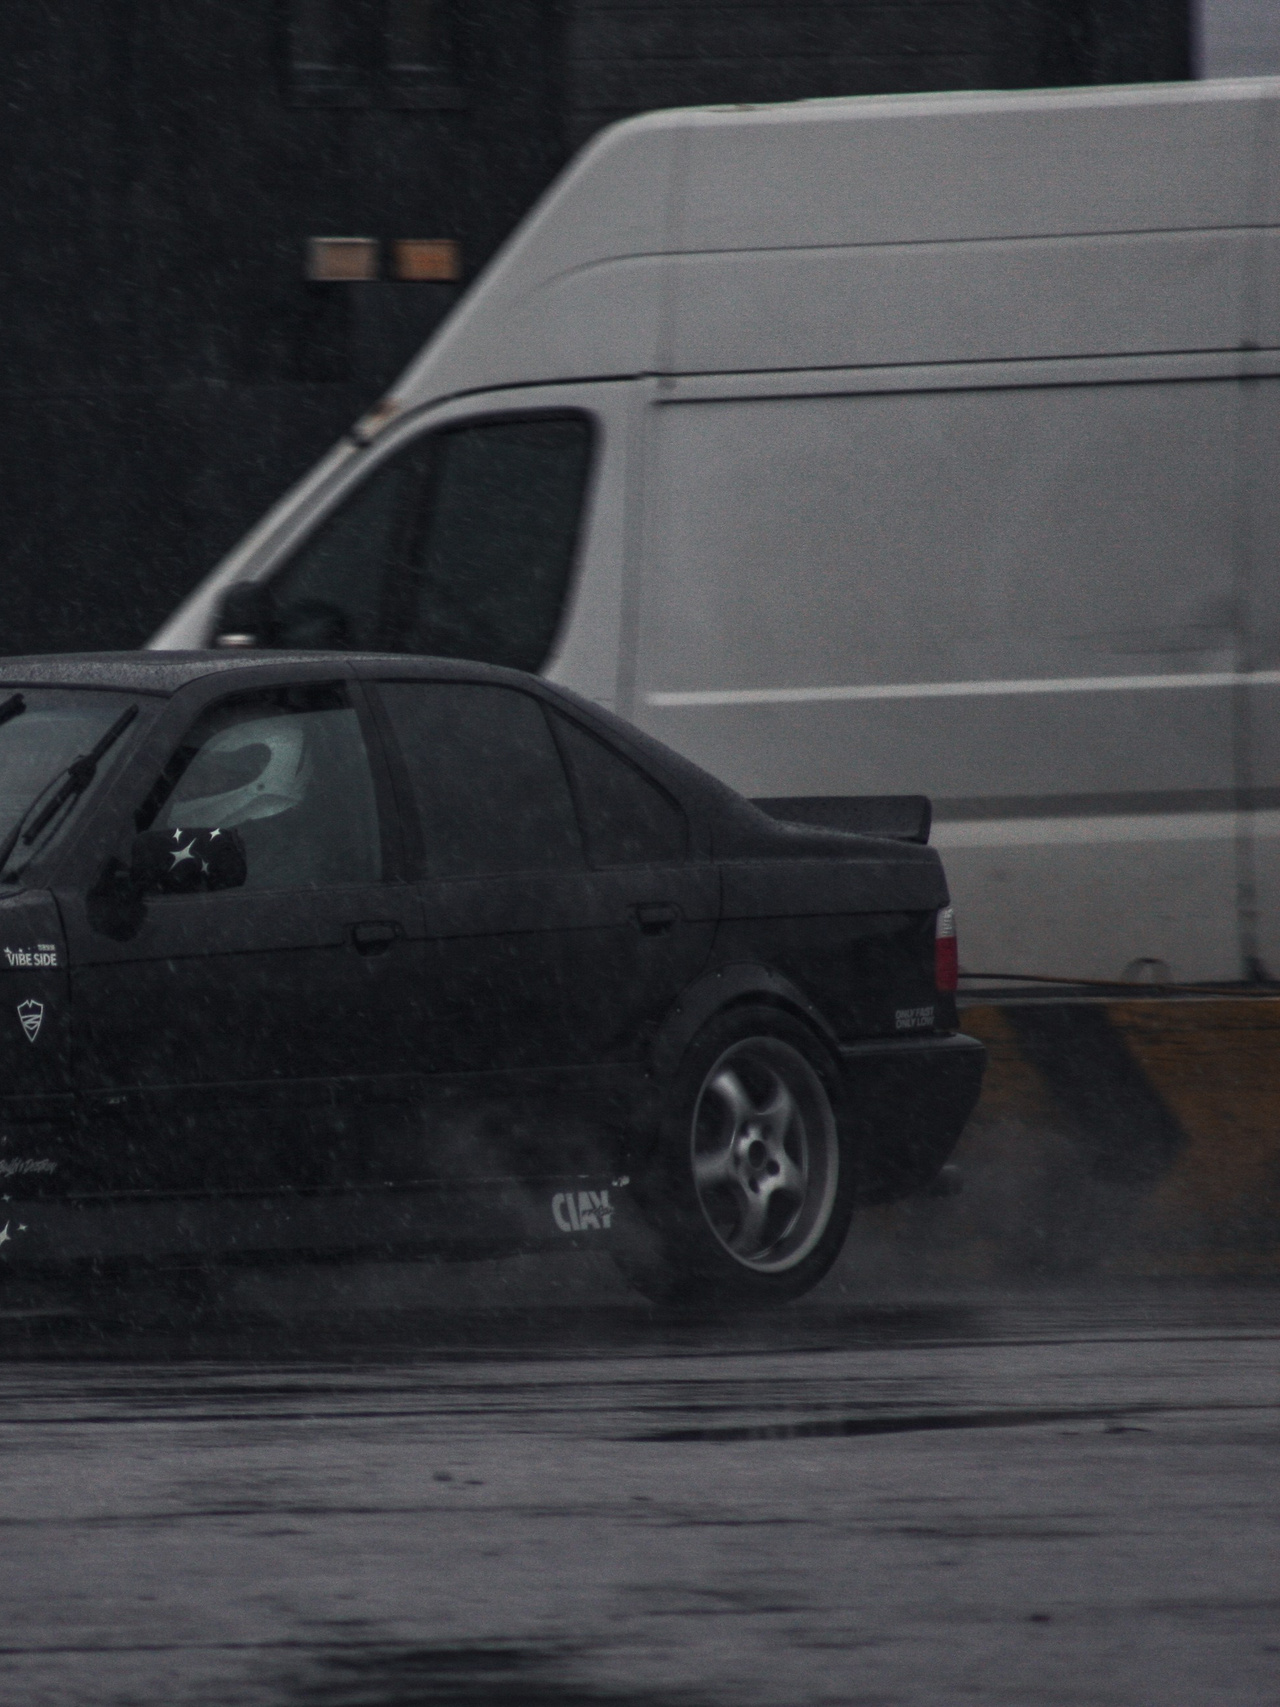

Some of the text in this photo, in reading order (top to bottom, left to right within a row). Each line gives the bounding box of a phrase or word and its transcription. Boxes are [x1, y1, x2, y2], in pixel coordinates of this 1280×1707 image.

[6, 953, 58, 966] VIBE SIDE
[895, 1006, 935, 1020] ONLY FAST
[895, 1016, 935, 1029] ONLY LOW
